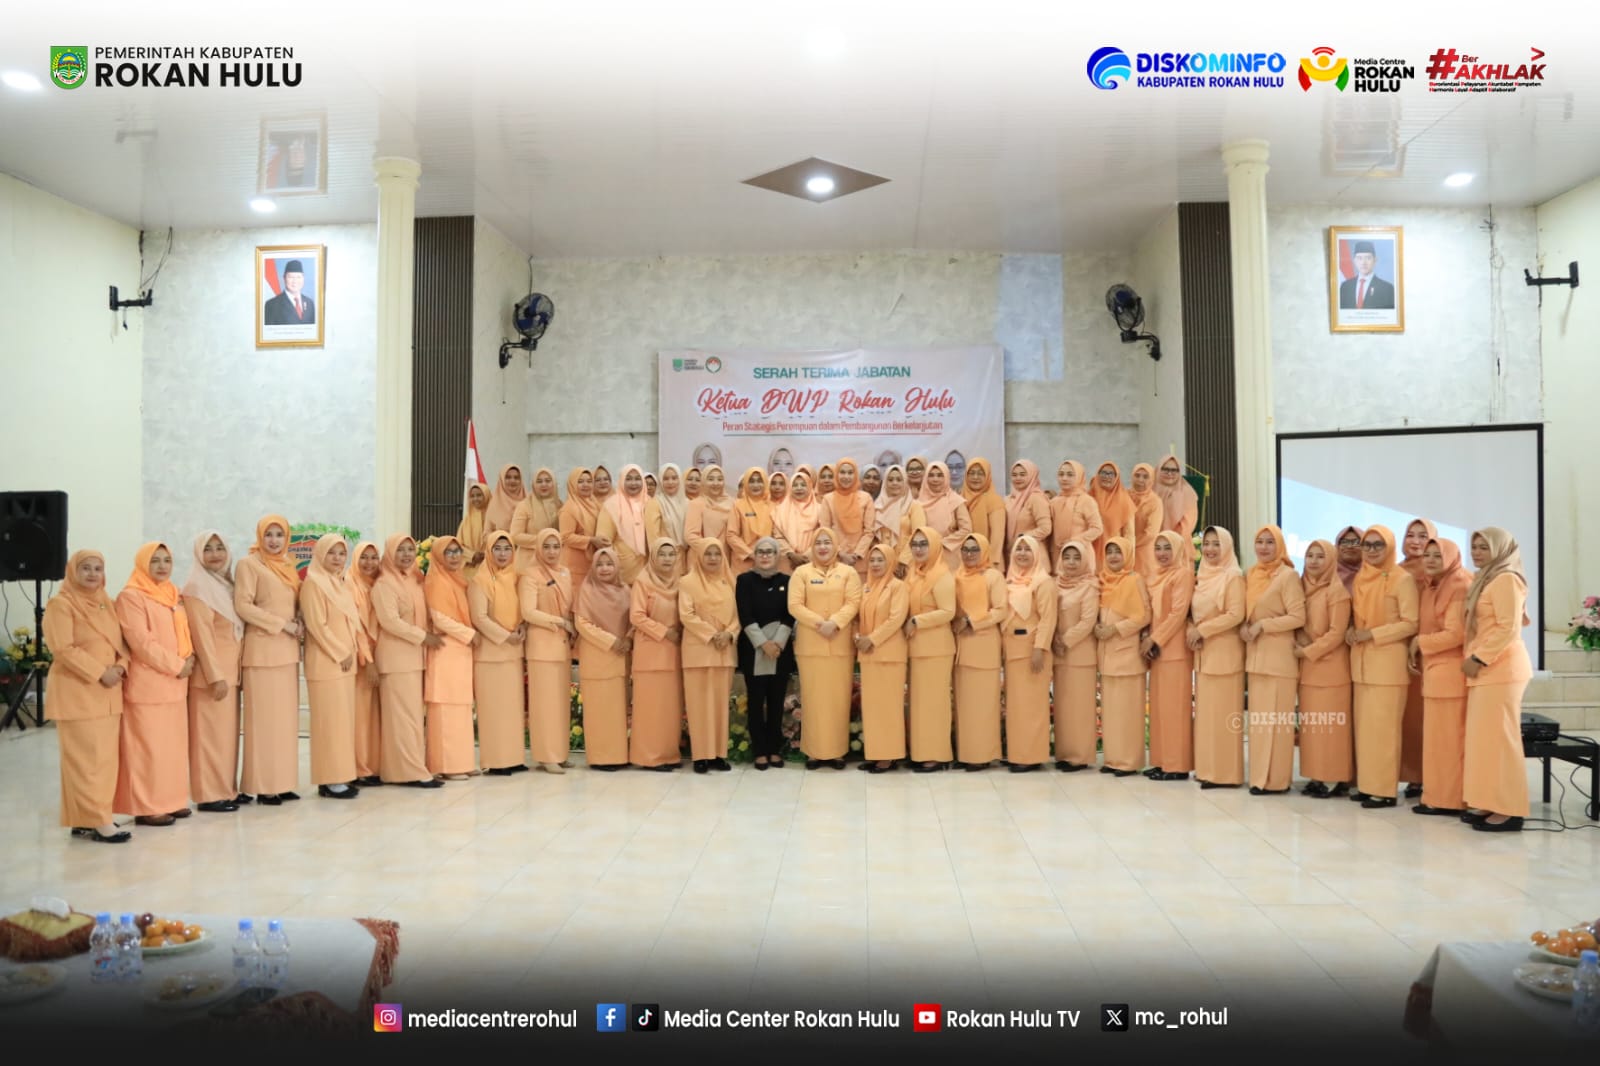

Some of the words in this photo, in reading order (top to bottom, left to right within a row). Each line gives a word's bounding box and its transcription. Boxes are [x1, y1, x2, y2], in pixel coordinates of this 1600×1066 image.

[753, 367, 799, 379] SERAH
[801, 367, 849, 379] TERIMA
[855, 366, 911, 378] JABATAN
[697, 387, 752, 415] Ketua
[760, 387, 830, 415] DWP
[838, 388, 896, 414] Rokan
[903, 386, 956, 413] Hulu
[722, 421, 744, 431] Peran
